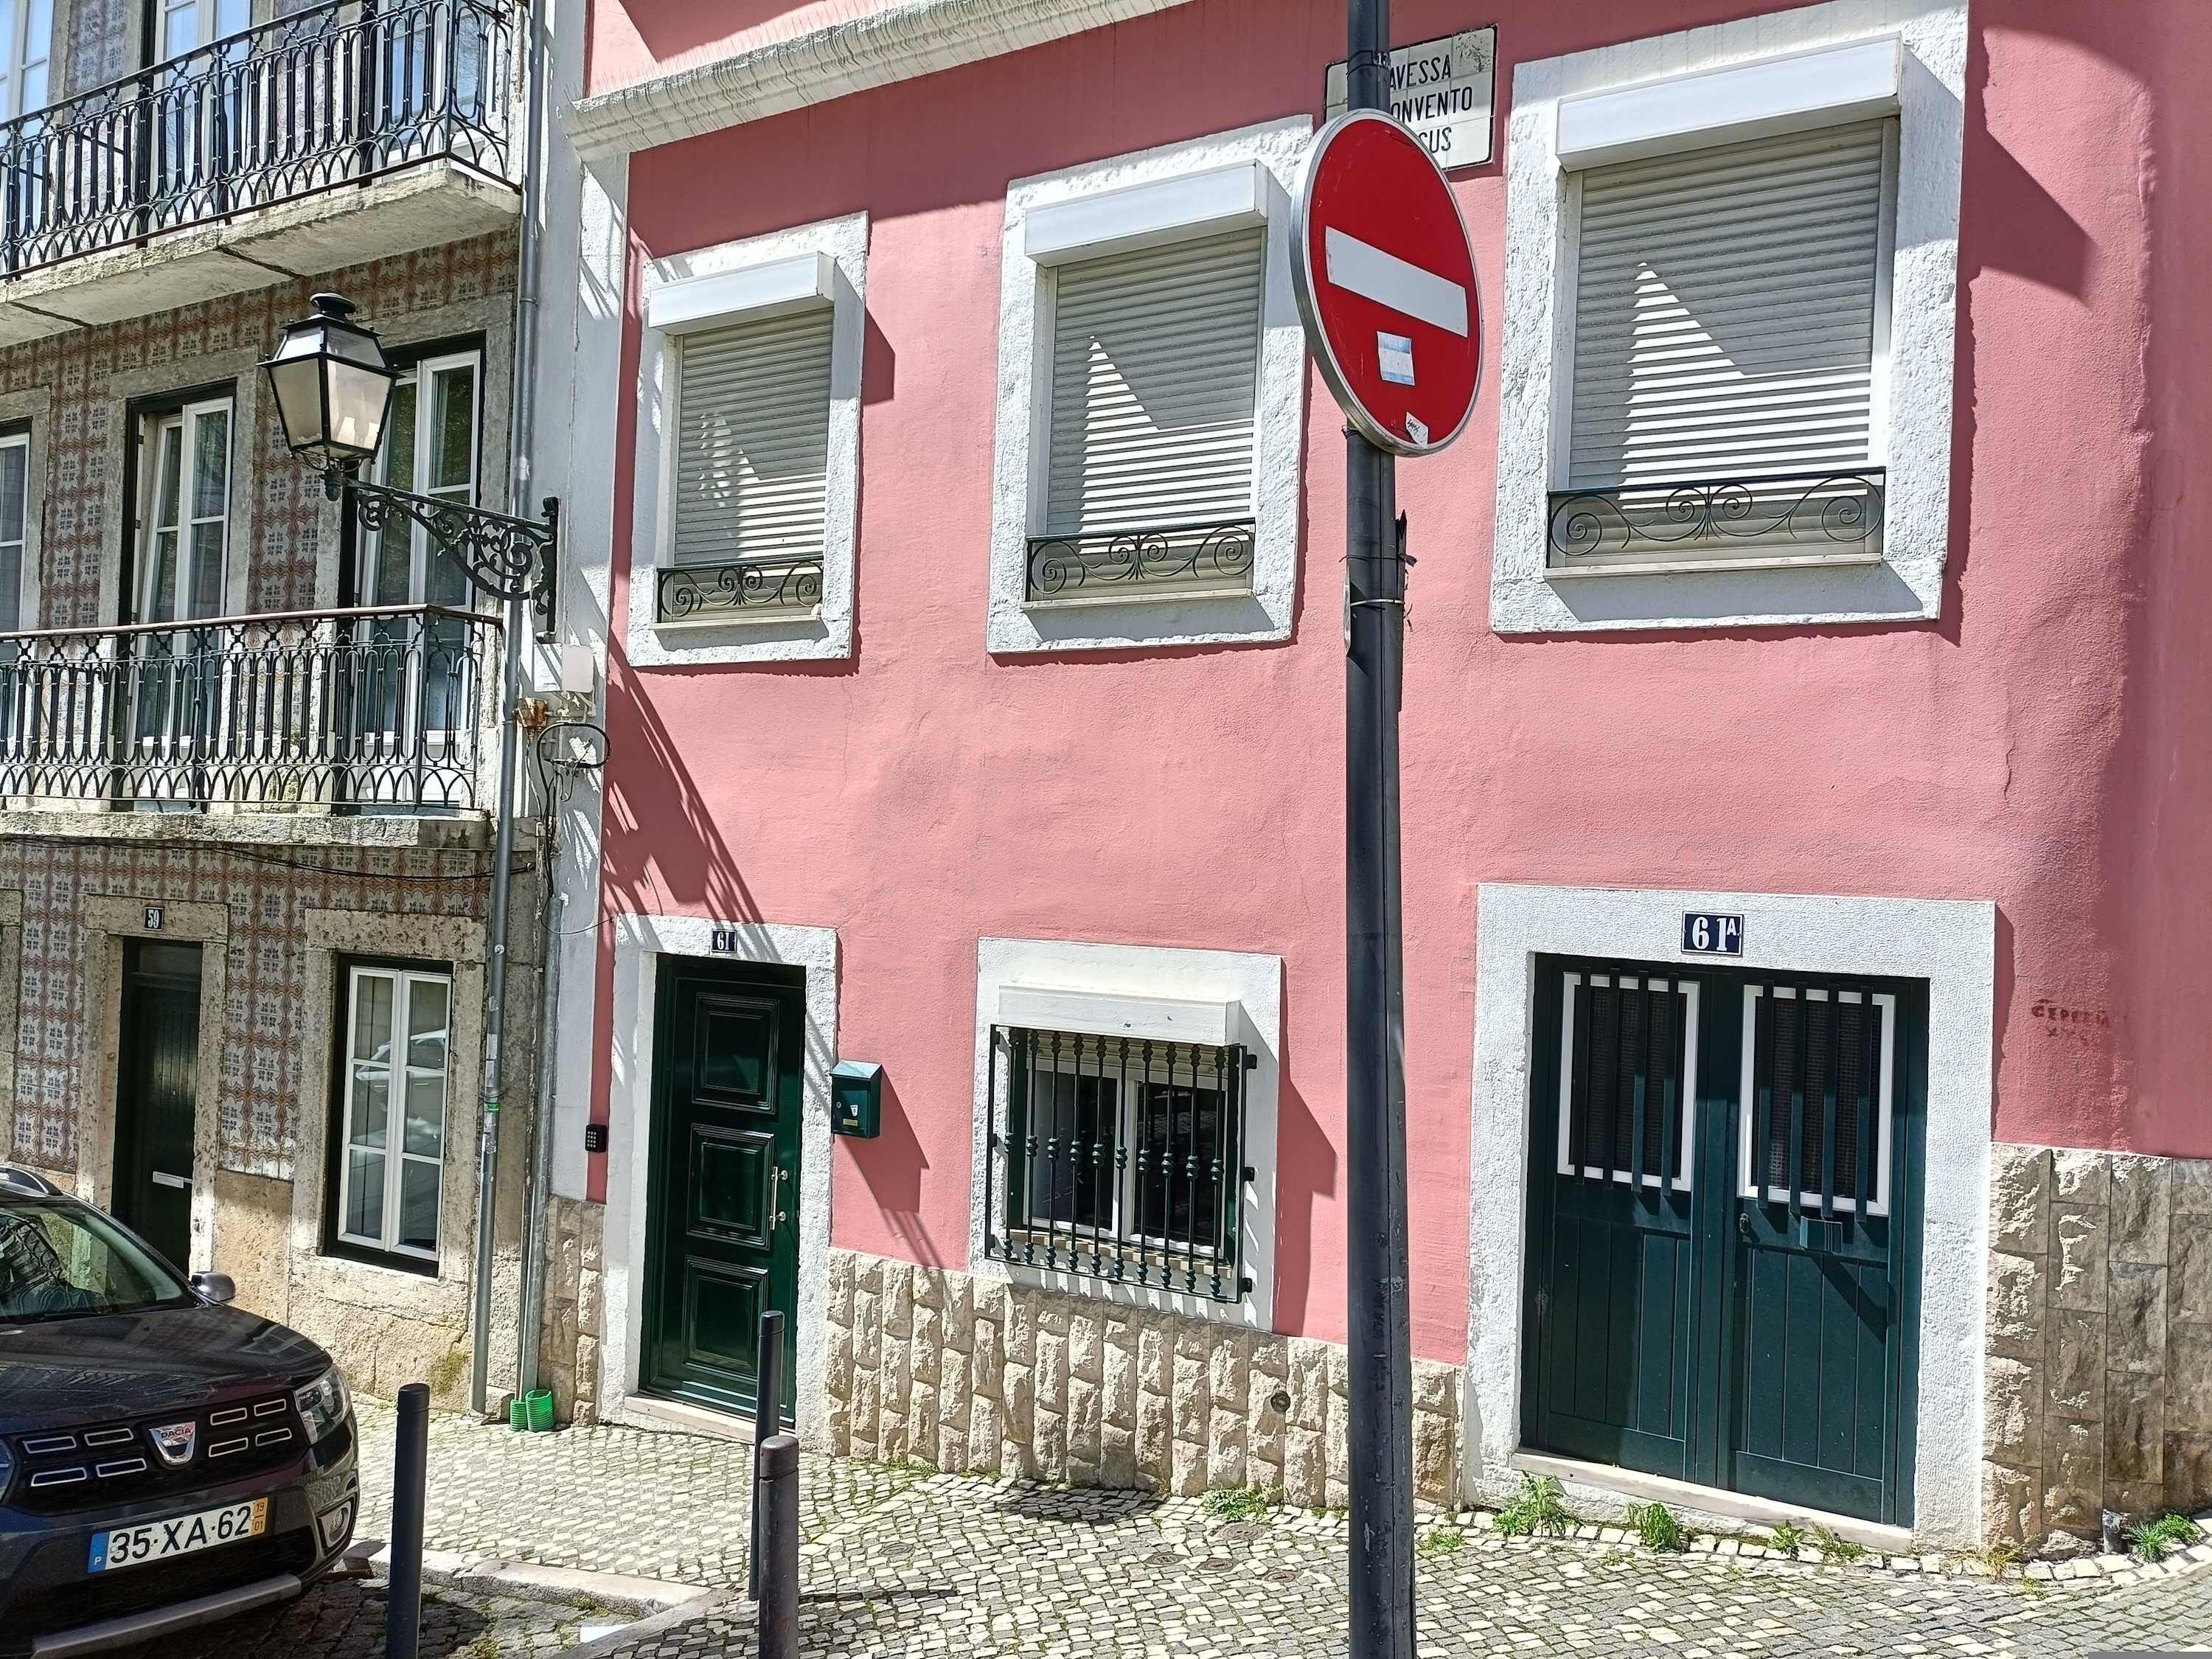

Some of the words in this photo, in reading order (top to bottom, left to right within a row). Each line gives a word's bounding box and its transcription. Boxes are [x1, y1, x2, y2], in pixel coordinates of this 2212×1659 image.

[1390, 55, 1451, 90] AVESSA
[1391, 86, 1472, 123] ONVENTO
[1419, 127, 1452, 153] SUS
[148, 909, 159, 928] 59
[717, 932, 729, 950] 61
[161, 1428, 191, 1438] DACIA
[94, 1557, 102, 1565] P
